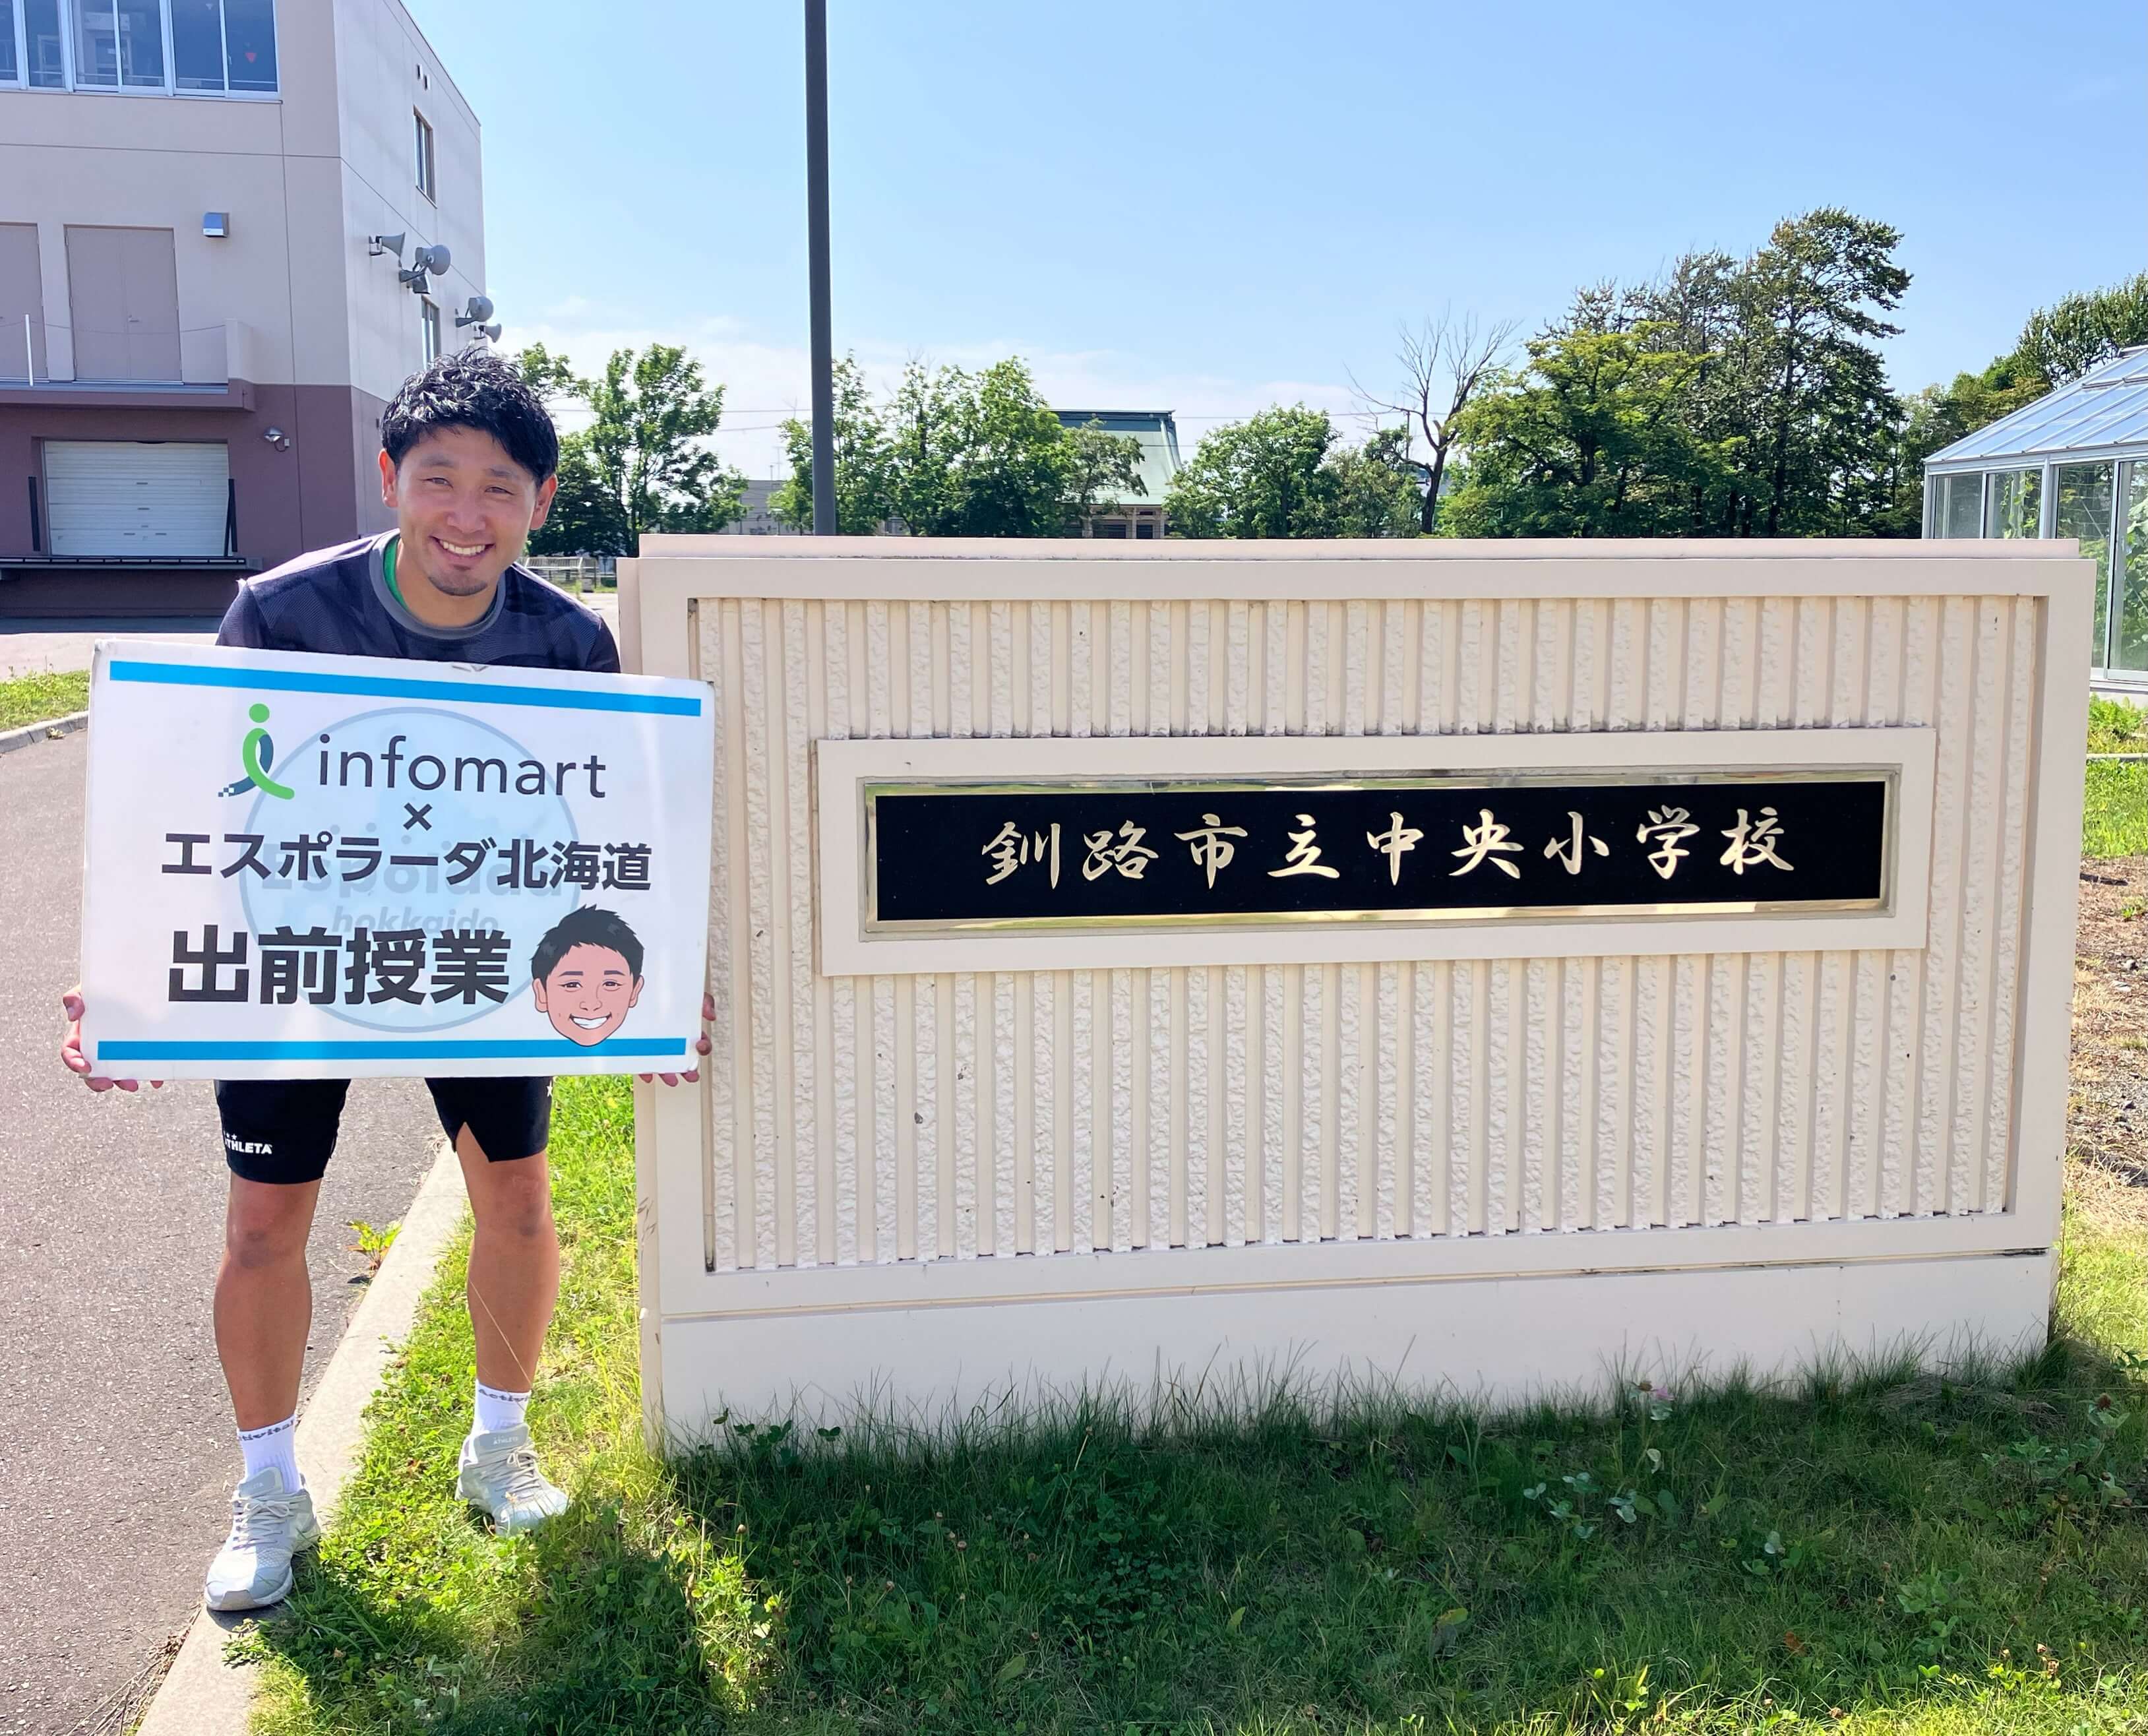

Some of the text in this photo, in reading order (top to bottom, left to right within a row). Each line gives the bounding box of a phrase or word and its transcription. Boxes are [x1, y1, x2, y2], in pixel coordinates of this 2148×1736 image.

[320, 734, 606, 798] infomart
[162, 832, 652, 890] エスポラーダ北海道
[981, 805, 1795, 889] 釧路市立中央小学校
[168, 925, 511, 1005] 出前授業
